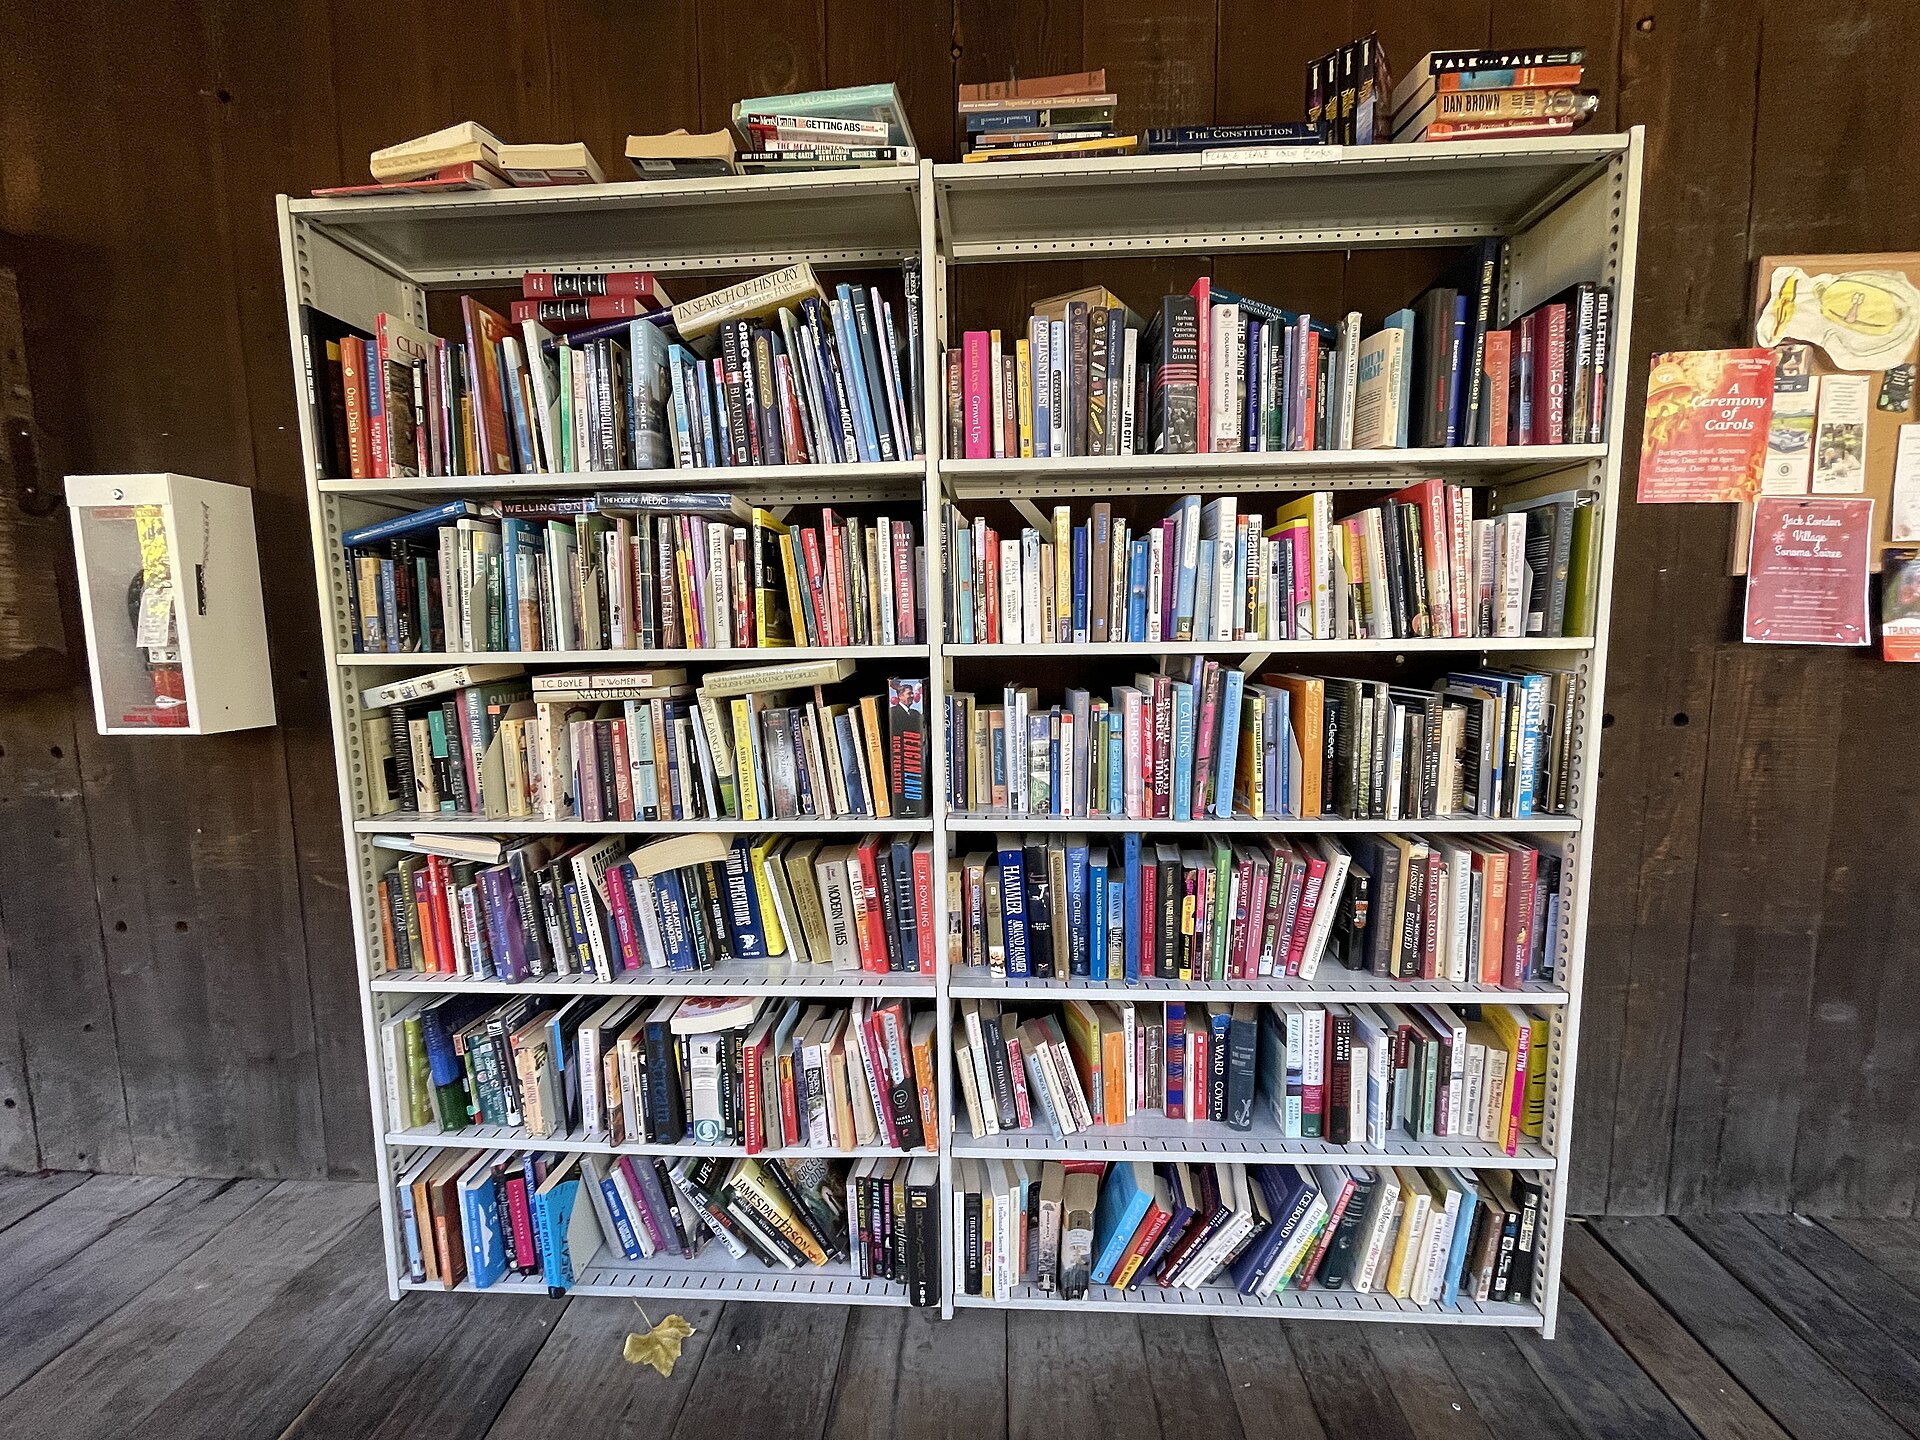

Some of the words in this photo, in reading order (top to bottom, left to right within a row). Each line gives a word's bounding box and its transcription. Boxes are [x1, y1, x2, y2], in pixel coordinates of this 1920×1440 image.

[1435, 58, 1478, 68] TALK
[1501, 54, 1544, 65] TALK
[1444, 95, 1462, 113] DAN
[1466, 94, 1500, 111] BROWN
[806, 121, 843, 131] GETTING
[844, 122, 860, 132] ABS
[1187, 131, 1209, 140] THE
[1214, 127, 1293, 138] CONSTITUTION
[678, 306, 692, 319] IN
[692, 291, 735, 312] SEARCH
[736, 284, 752, 298] OF
[753, 266, 799, 292] HISTORY
[1580, 292, 1594, 330] NOBODY
[1237, 320, 1245, 340] THE
[367, 347, 375, 362] TIA
[724, 332, 737, 370] PETER
[971, 339, 980, 369] marian
[1579, 333, 1592, 365] WALKS
[738, 322, 748, 358] GREG
[743, 362, 753, 406] RUCKA
[368, 364, 378, 410] WILLIAMS
[1038, 388, 1048, 408] MIST
[1728, 383, 1740, 394] A
[730, 387, 744, 442] BLAUNER
[972, 395, 981, 424] Grown
[1550, 370, 1563, 437] FORGE
[1692, 396, 1767, 408] Ceremony
[1722, 407, 1738, 420] of
[1124, 411, 1133, 427] JAR
[1705, 419, 1754, 430] Carols
[972, 425, 981, 443] Ups
[1123, 430, 1131, 449] CITY
[505, 503, 581, 513] WELLINGTON
[1782, 514, 1804, 529] Jack
[1805, 514, 1842, 526] London
[713, 537, 722, 554] TIME
[1480, 531, 1492, 556] HARLAN
[1775, 545, 1812, 556] Sonoma
[1793, 530, 1828, 548] Village
[714, 557, 722, 572] FOR
[899, 554, 909, 578] PAUL
[1246, 528, 1261, 578] beautiful
[755, 565, 763, 587] Terriers
[1480, 559, 1493, 583] COBEN
[714, 574, 723, 603] HEROES
[900, 582, 909, 614] THEROUX
[1481, 597, 1491, 627] CAUGHT
[577, 688, 642, 699] NAPOLEON
[709, 673, 781, 690] ENGLISH-SPEAKING
[784, 671, 819, 681] PEOPLES
[468, 692, 478, 719] SAVAGE
[1130, 699, 1140, 728] SPLIT
[1427, 703, 1435, 722] TYLL
[1525, 682, 1541, 734] MOSLEY
[471, 720, 481, 749] HARVEST
[706, 718, 719, 748] LEAVING
[1178, 701, 1191, 759] CALLINGS
[1326, 723, 1338, 759] Cleeves
[1426, 726, 1434, 753] DANIEL
[740, 746, 749, 765] ABBY
[1131, 731, 1140, 759] ROCK
[1521, 737, 1535, 771] KNOWN
[712, 749, 725, 774] HOME
[903, 731, 923, 800] REAGANLAND
[742, 767, 751, 803] JIMENEZ
[1424, 756, 1432, 795] KEHLMANN
[1520, 774, 1533, 794] EVIL
[726, 848, 743, 875] GRAND
[918, 869, 926, 882] J.K.
[1408, 864, 1419, 901] HOSSEINI
[521, 881, 532, 908] CECELIA
[661, 889, 671, 917] WILLIAM
[729, 876, 750, 927] EXPECTATIONS
[827, 884, 844, 918] MODERN
[853, 880, 864, 901] LOST
[1003, 865, 1023, 915] HAMMER
[1303, 876, 1321, 908] RUNNER
[1428, 866, 1439, 917] PELICAN
[517, 895, 529, 930] JERUSALEM
[669, 900, 678, 911] THE
[856, 903, 867, 922] MAN
[919, 884, 930, 927] ROWLING
[525, 909, 538, 942] HOLLAND
[672, 912, 681, 927] LAST
[831, 919, 847, 946] TIMES
[1012, 919, 1024, 945] ARMAND
[1404, 911, 1415, 950] ECHOED
[664, 918, 678, 955] MANCHESTER
[675, 929, 683, 942] LION
[1426, 919, 1437, 953] ROAD
[1014, 945, 1027, 973] HAMMER
[1290, 1017, 1300, 1054] THAMES
[1214, 1044, 1225, 1075] WARD
[1214, 1081, 1224, 1113] COVET
[807, 1164, 827, 1188] GODS
[537, 1204, 546, 1220] BEAT
[1299, 1190, 1315, 1209] ICE
[734, 1179, 764, 1207] JAMES
[760, 1203, 811, 1251] PATTERSON
[859, 1209, 867, 1229] BEFORE
[996, 1206, 1004, 1233] Husband's
[1279, 1208, 1305, 1239] BOUND
[541, 1232, 551, 1251] REAPER
[894, 1202, 907, 1264] Mayflower
[969, 1216, 977, 1269] THUNDERSTRUCK
[996, 1233, 1004, 1253] Secret
